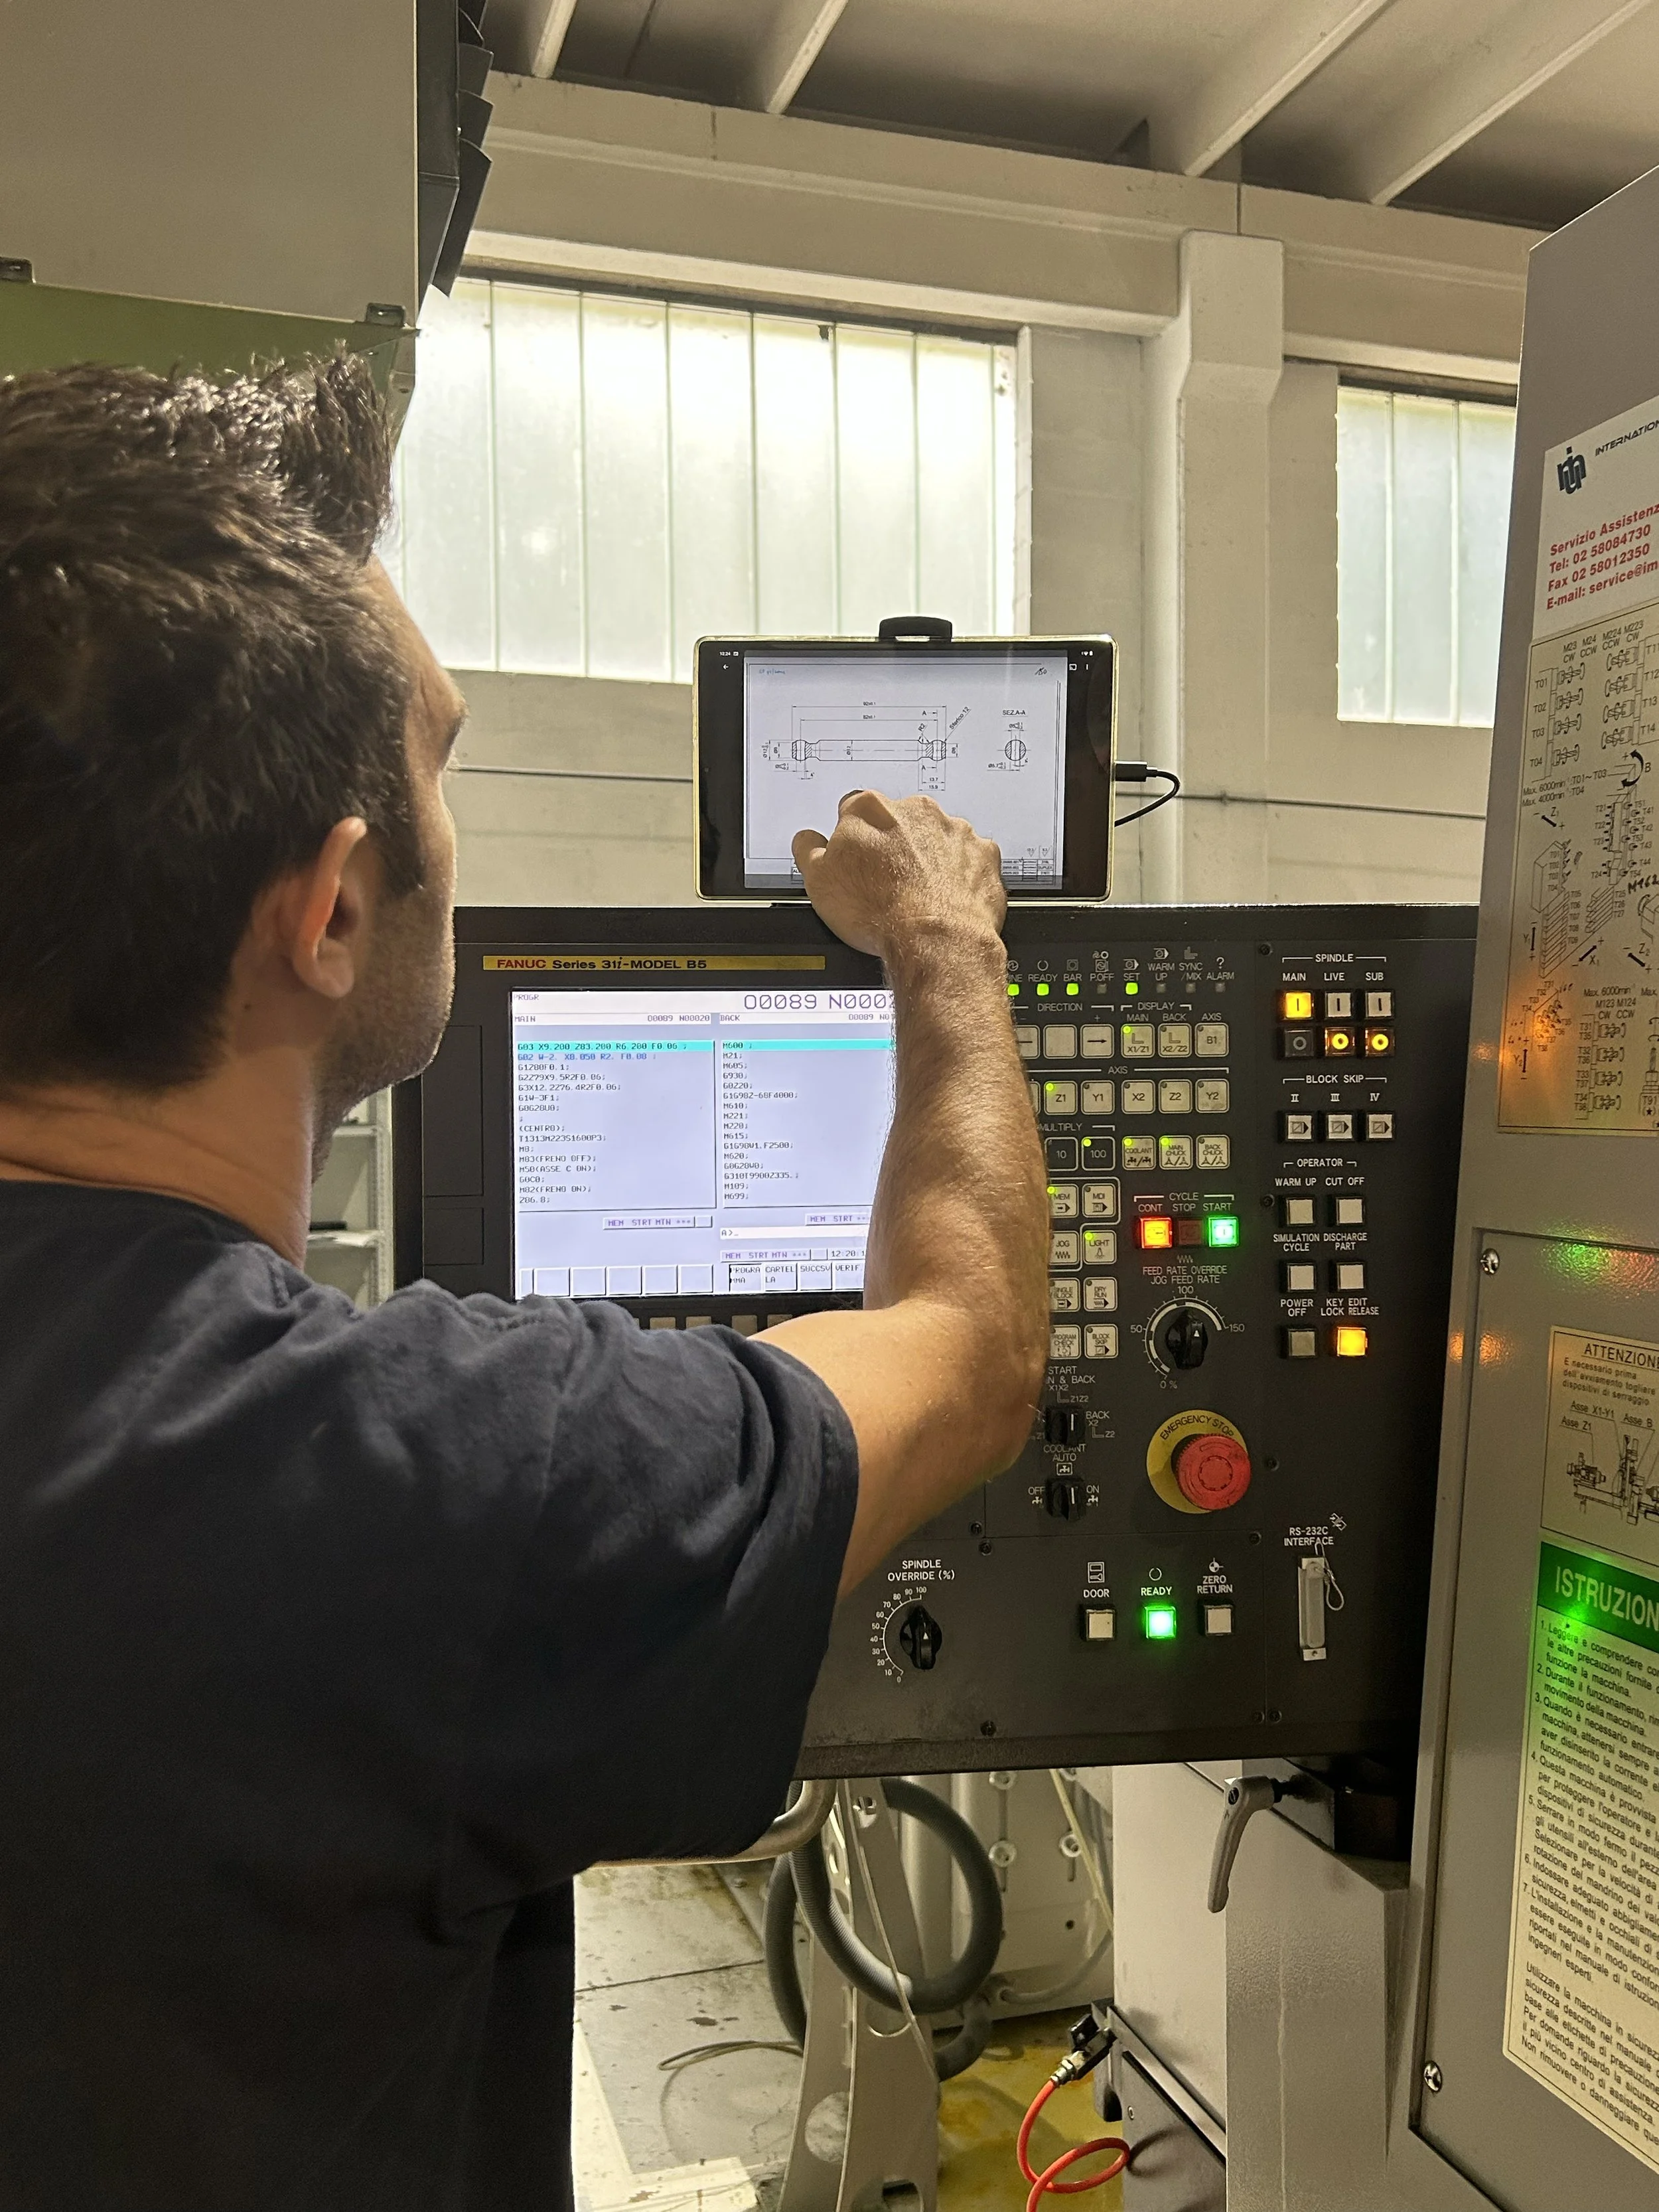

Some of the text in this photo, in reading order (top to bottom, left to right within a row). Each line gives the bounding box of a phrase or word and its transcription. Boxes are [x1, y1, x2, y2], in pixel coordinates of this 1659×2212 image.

[1550, 530, 1595, 555] Servizio
[1550, 524, 1650, 573] Tel: 02 58084730
[1548, 544, 1650, 591] Fax 02 58012350
[1547, 560, 1658, 609] E-mail: service@im
[1563, 621, 1644, 652] M23 M24 M224 M223
[1563, 646, 1597, 663] CW CCW
[1535, 678, 1547, 688] T01
[1644, 763, 1651, 773] B
[498, 960, 546, 968] FANUC
[687, 960, 707, 968] B5
[1090, 973, 1115, 982] P.OFF
[1123, 973, 1140, 982] SET
[1181, 972, 1202, 981] /MIX
[1108, 1066, 1128, 1074] AXIS
[1055, 1094, 1066, 1102] Z1
[1291, 1094, 1299, 1102] II
[1056, 1150, 1066, 1159] 10
[1348, 1177, 1365, 1185] OFF
[1202, 1203, 1232, 1211] START
[1273, 1233, 1320, 1242] SIMULATION
[1323, 1232, 1368, 1241] DISCHARGE
[1283, 1243, 1309, 1252] CYCLE
[1191, 1265, 1228, 1274] OVERRIDE
[1151, 1276, 1167, 1285] JOG
[1177, 1286, 1194, 1294] 100
[1281, 1299, 1313, 1307] POWER
[1287, 1308, 1307, 1317] OFF
[1321, 1307, 1379, 1316] LOCK RELEASE
[1571, 1400, 1588, 1412] Asse
[1160, 1416, 1234, 1440] EMERGENCY STOP
[1043, 1443, 1086, 1453] COOLANT
[1289, 1526, 1329, 1536] RS-232C
[1284, 1537, 1334, 1546] INTERFACE
[902, 1560, 941, 1570] SPINDLE
[888, 1570, 955, 1581] OVERRIDE (%)
[1083, 1589, 1110, 1597] DOOR
[1141, 1587, 1173, 1595] READY
[1197, 1585, 1233, 1593] RETURN
[1555, 1566, 1659, 1631] ISTRUZION
[1546, 1667, 1575, 1688] Durante
[1544, 1697, 1572, 1718] Quando
[1606, 1712, 1646, 1736] macchina.
[1540, 1740, 1595, 1775] funzionamento
[1540, 1755, 1566, 1776] Questa
[1527, 1960, 1560, 1991] Utilizzare
[1574, 1996, 1612, 2028] macchina
[1522, 2035, 1577, 2084] Non rimuovere
